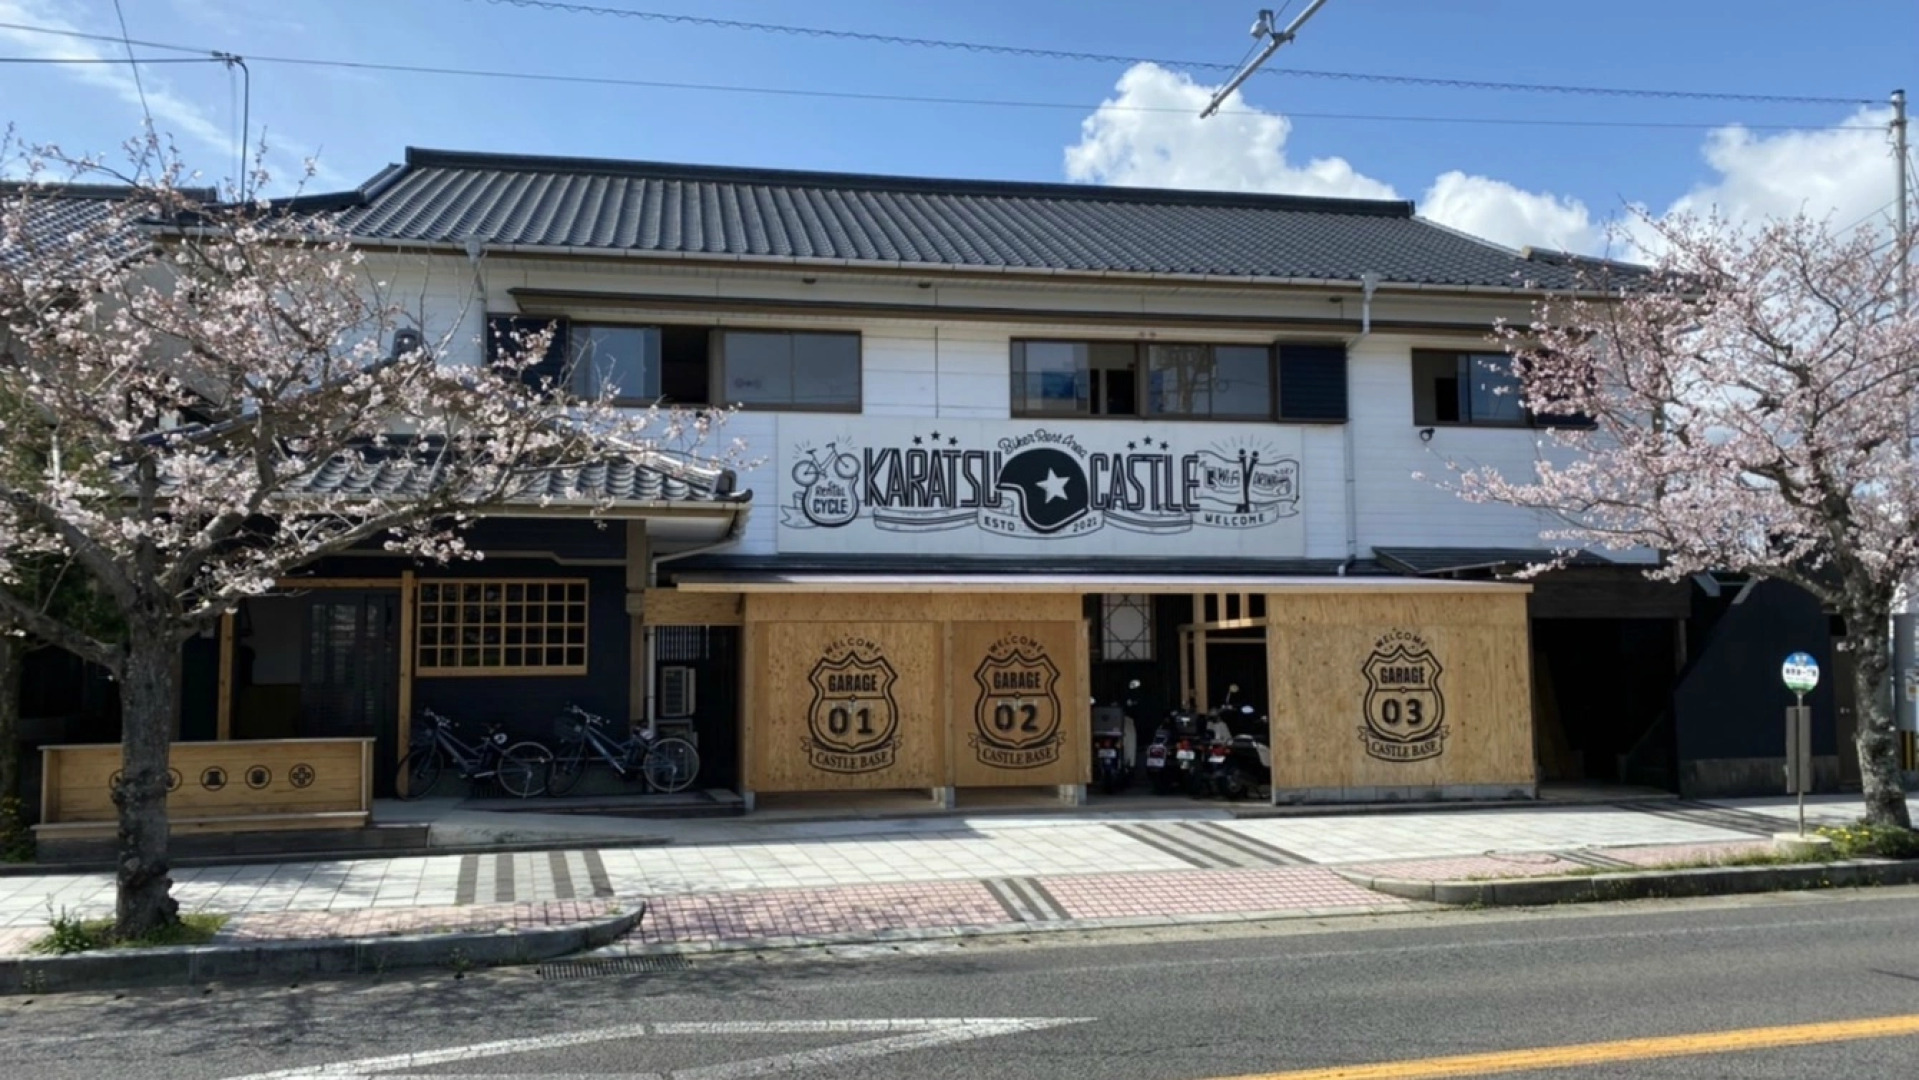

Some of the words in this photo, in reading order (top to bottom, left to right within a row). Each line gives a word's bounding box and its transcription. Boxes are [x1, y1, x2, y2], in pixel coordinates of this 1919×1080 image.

[863, 447, 1003, 508] KARATSU
[1089, 452, 1200, 512] CASTLE
[813, 498, 849, 515] CYCLE
[1205, 513, 1264, 527] WELCOME
[824, 636, 882, 656] WELCOME
[988, 634, 1044, 654] WELCOME
[1375, 632, 1428, 648] WELCOME
[828, 674, 878, 693] GARAGE
[993, 671, 1041, 690] GARAGE
[1380, 666, 1426, 684] GARAGE
[828, 706, 874, 735] 01
[994, 704, 1039, 733] 02
[1381, 698, 1424, 725] 03
[983, 749, 1024, 765] CASTLE
[1024, 750, 1052, 764] BASE
[1371, 741, 1409, 758] CASTLE
[1411, 741, 1438, 756] BASE
[815, 751, 859, 769] CASTLE
[860, 752, 889, 767] BASE
